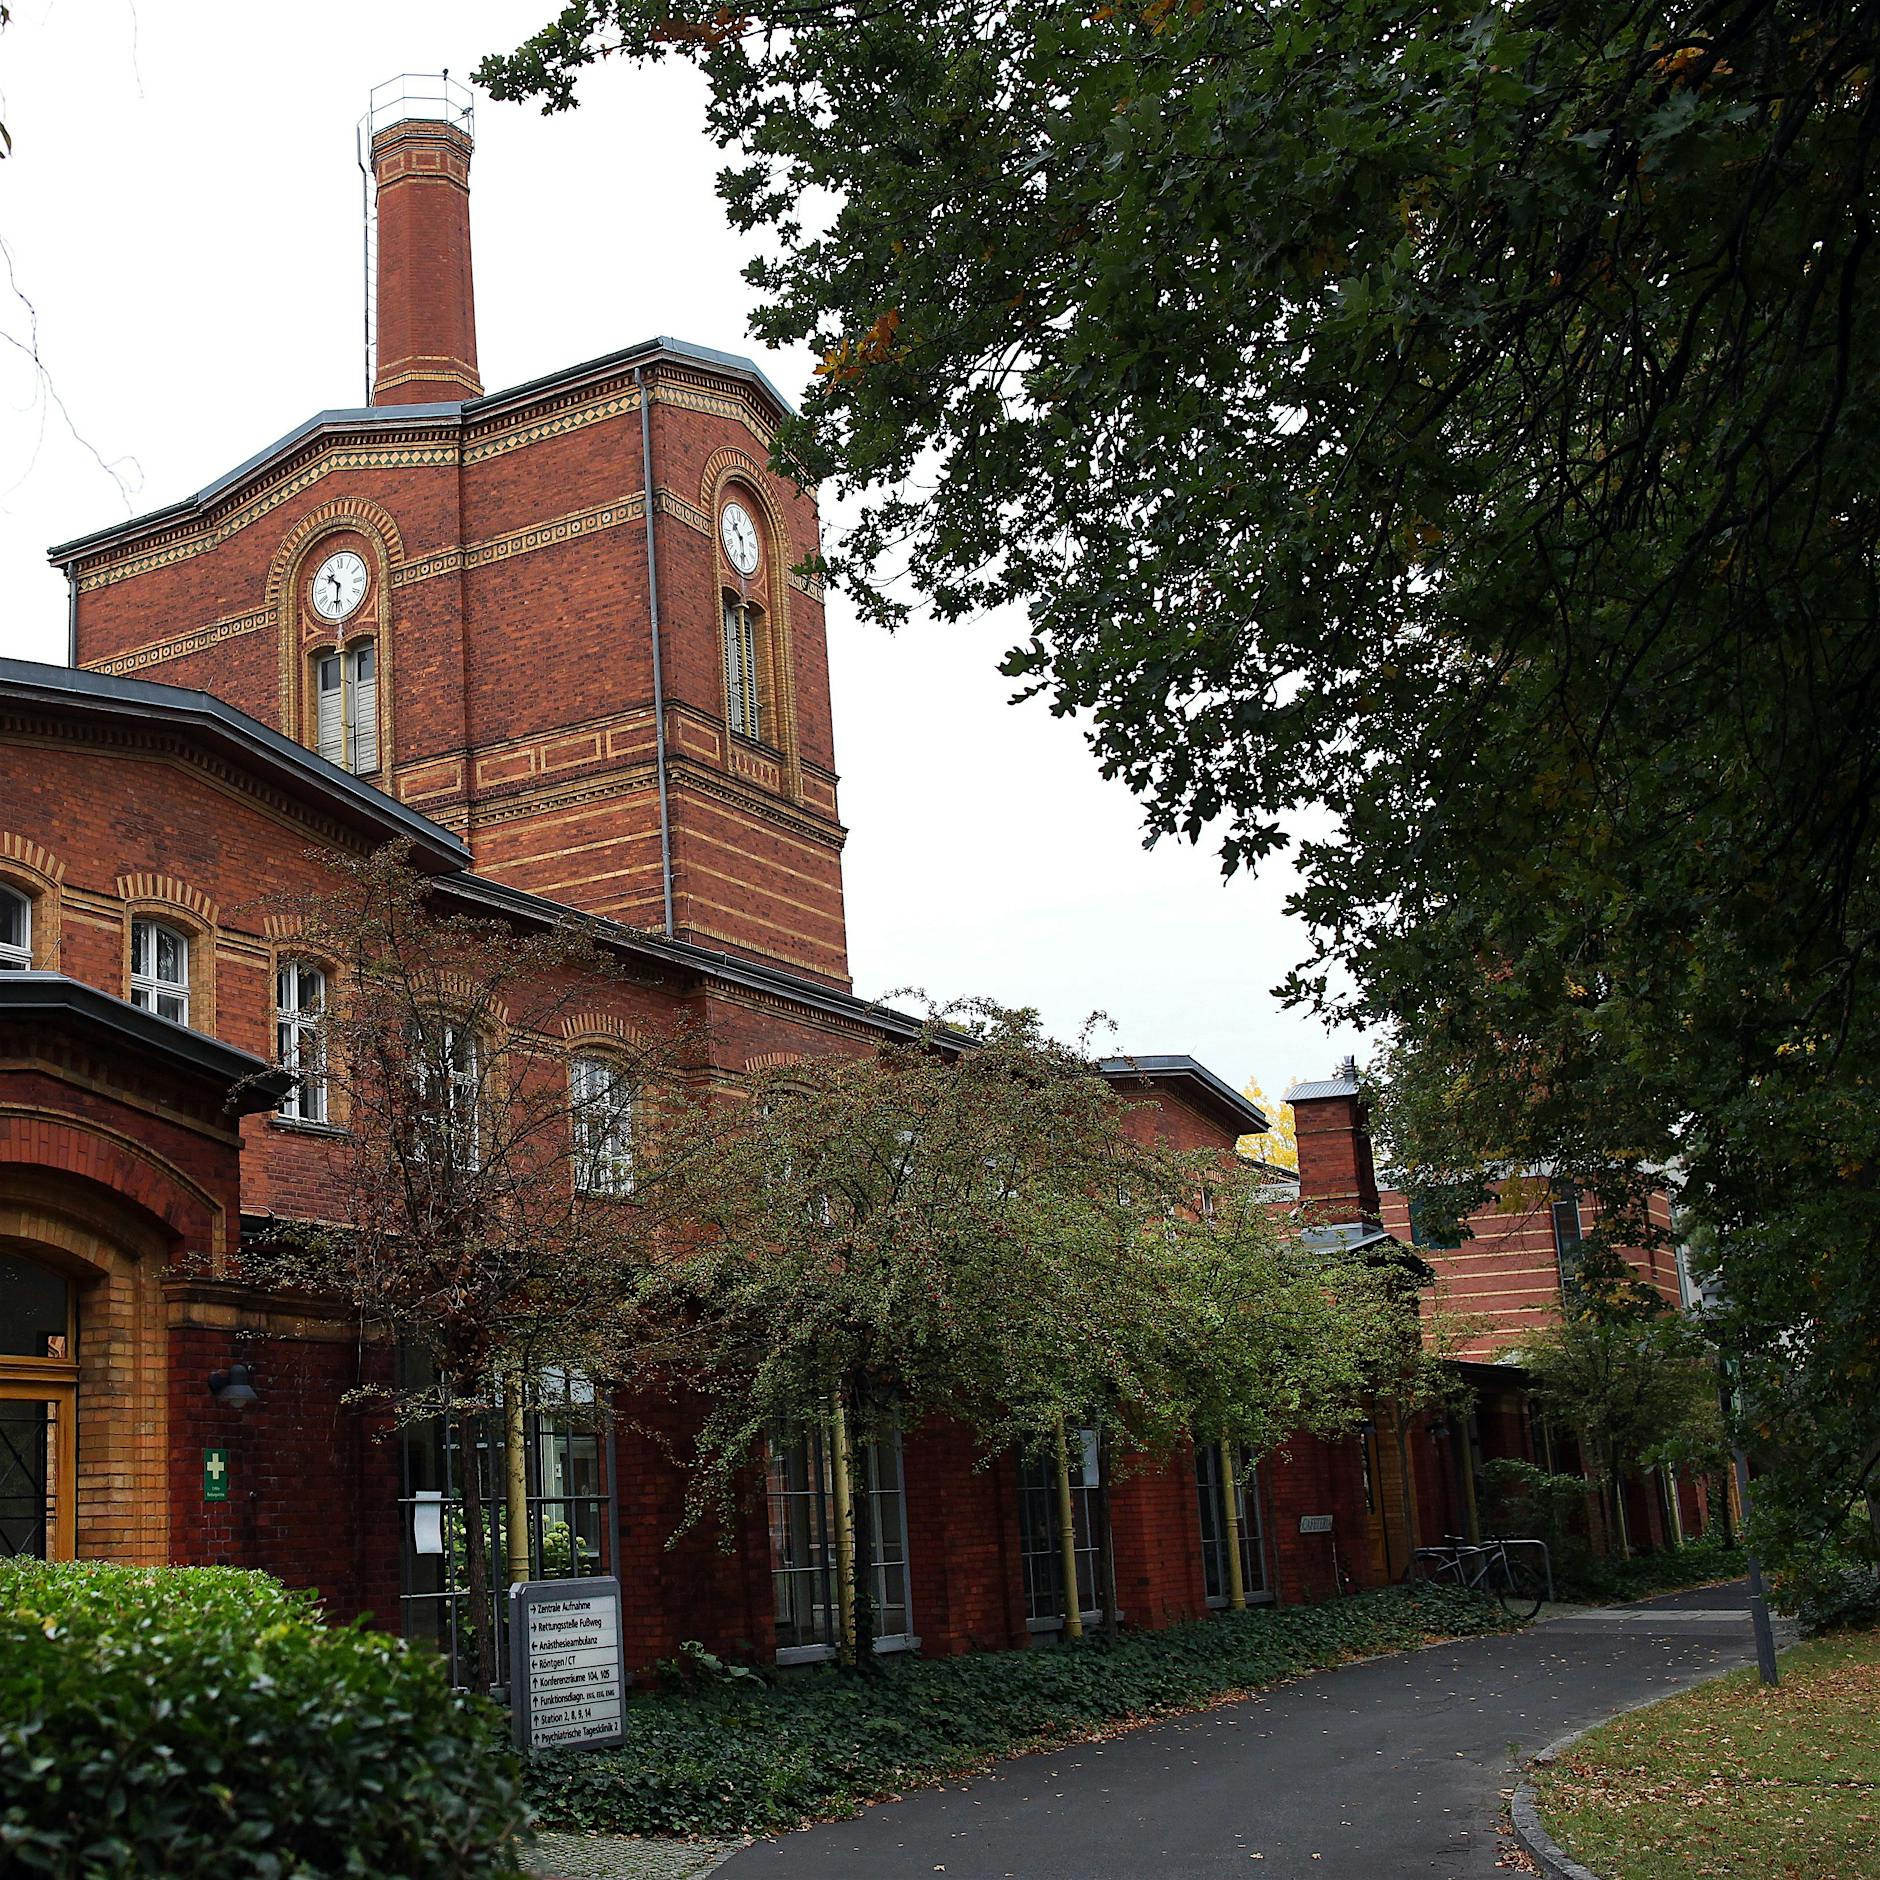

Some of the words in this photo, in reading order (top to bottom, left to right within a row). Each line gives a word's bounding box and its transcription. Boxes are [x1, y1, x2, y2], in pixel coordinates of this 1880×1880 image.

[538, 1603, 560, 1613] Zentrale
[563, 1601, 590, 1611] Aufnahme
[539, 1619, 578, 1632] Rettungsstelle
[580, 1618, 602, 1628] Fußweg
[540, 1636, 597, 1650] Anästhesieambulanz
[540, 1674, 585, 1686] Konferenzräume
[601, 1669, 609, 1679] 105
[541, 1692, 584, 1705] Funktionsdiagn.
[541, 1715, 562, 1725] Station
[585, 1708, 591, 1717] 14
[542, 1728, 581, 1743] Psychiatrische
[583, 1723, 613, 1737] Tagesklinik
